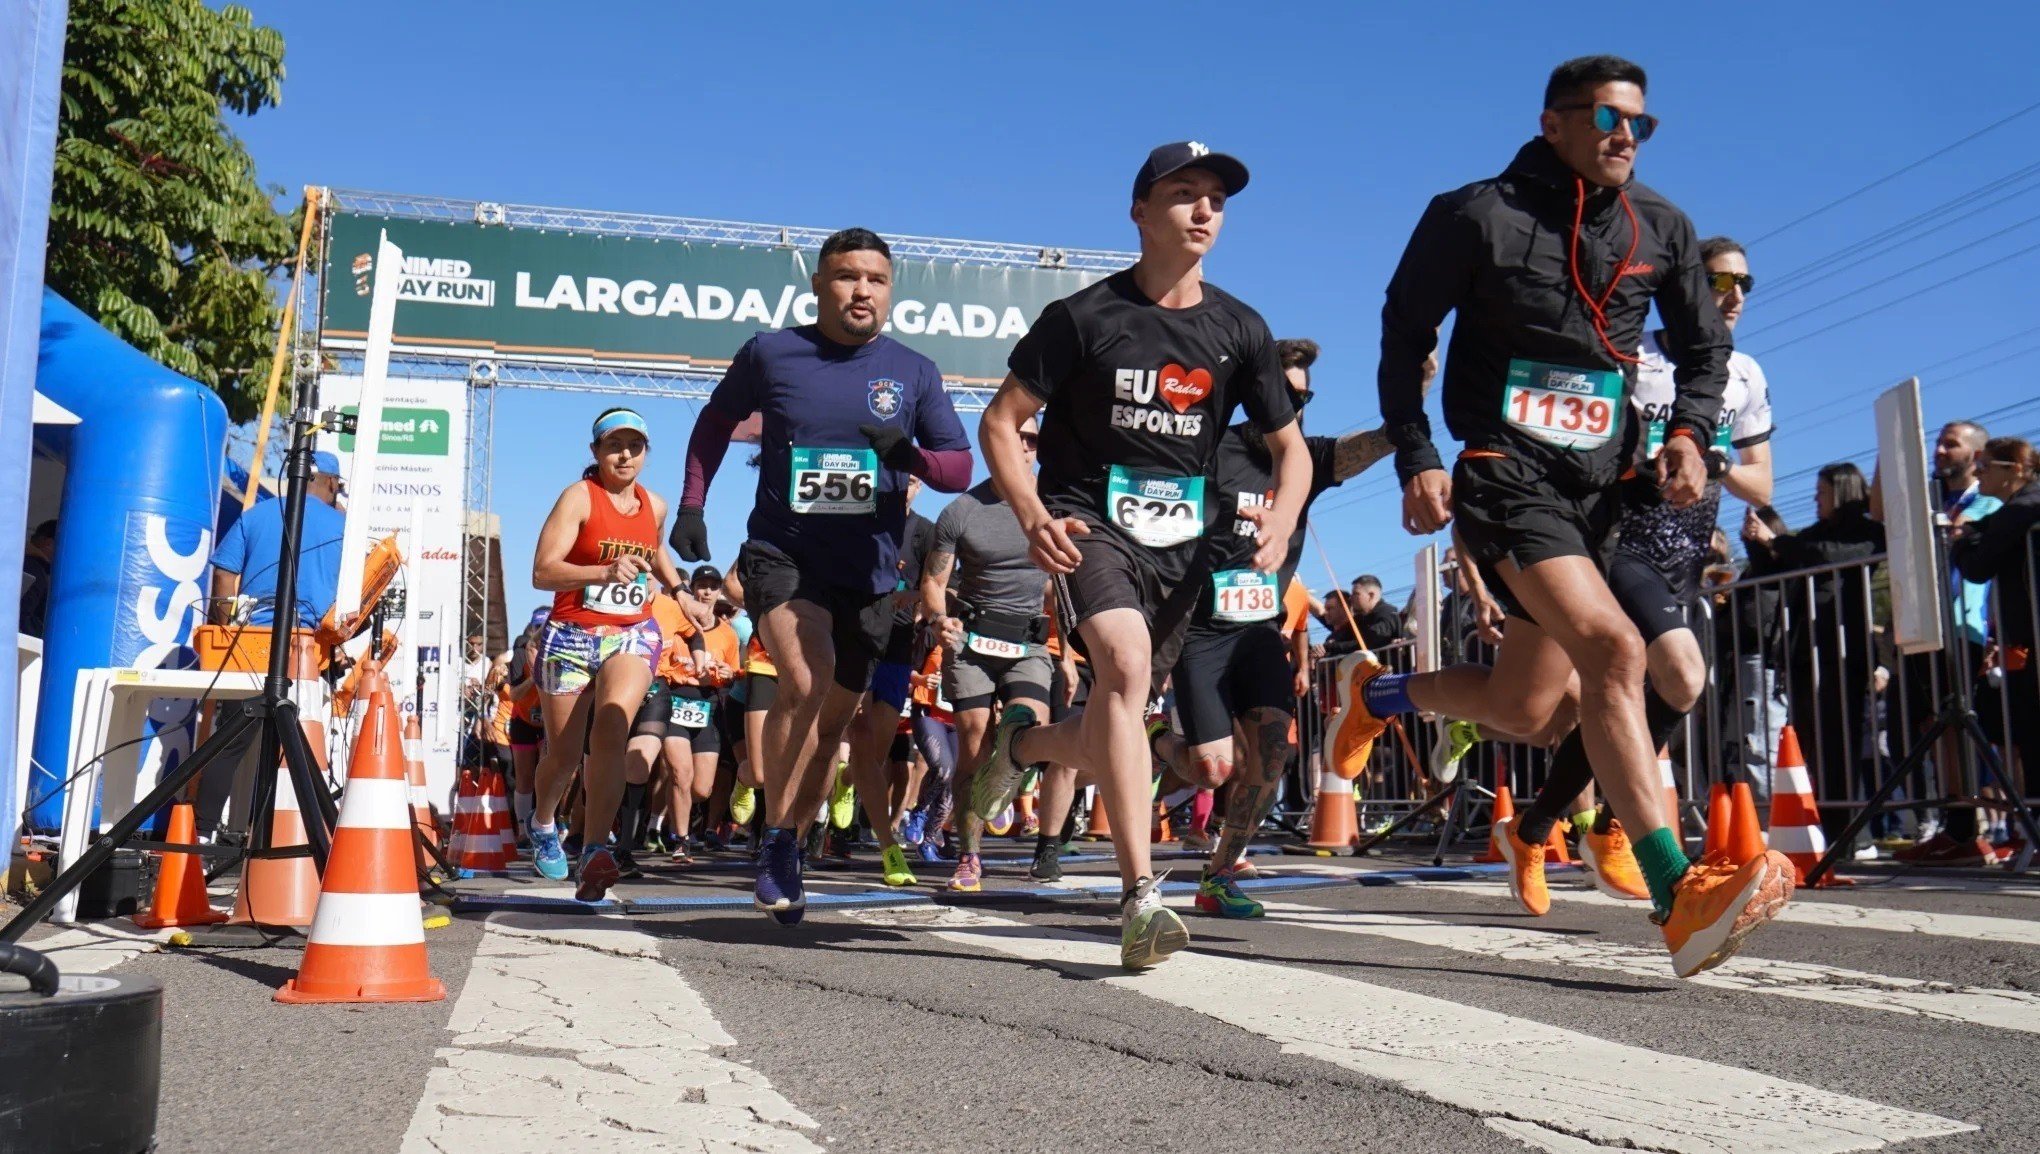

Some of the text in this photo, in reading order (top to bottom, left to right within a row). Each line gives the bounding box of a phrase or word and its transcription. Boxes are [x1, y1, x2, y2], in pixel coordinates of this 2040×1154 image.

[401, 256, 471, 278] NIMED
[397, 278, 483, 300] AY RUN
[516, 271, 1029, 340] LARGADA/CGADA
[1115, 368, 1204, 404] EU Radan
[1549, 380, 1590, 391] DAY RUN
[1111, 404, 1203, 436] ESPORTES
[1512, 389, 1610, 434] 1139
[381, 419, 415, 433] med
[382, 434, 414, 442] Sinos/RS
[823, 453, 853, 461] UNIMED
[841, 461, 857, 469] RUN
[798, 472, 872, 502] 556
[1146, 488, 1180, 498] DAY RUN
[421, 547, 459, 561] adan
[598, 540, 657, 563] TITAN
[594, 583, 644, 607] 766
[1220, 587, 1274, 611] 1138
[974, 637, 1021, 655] 1081
[671, 708, 704, 724] 682
